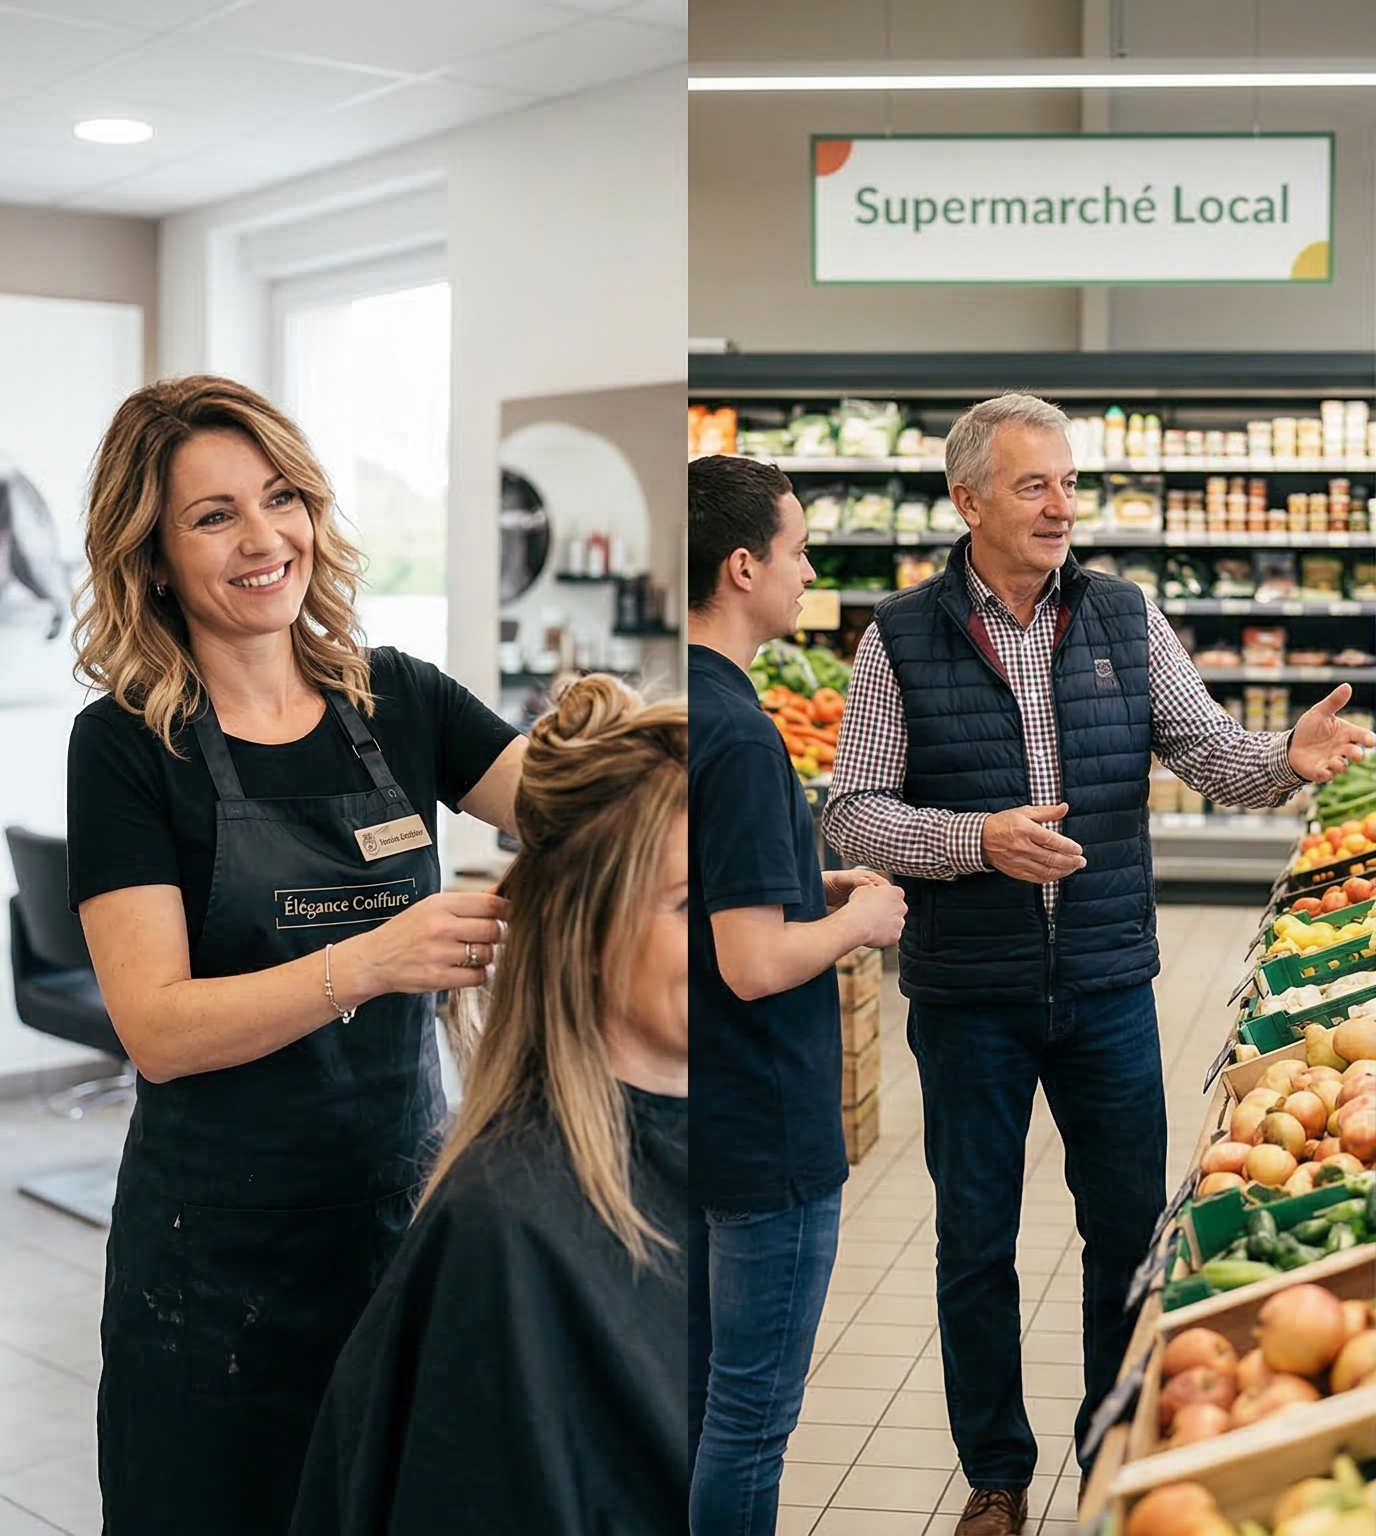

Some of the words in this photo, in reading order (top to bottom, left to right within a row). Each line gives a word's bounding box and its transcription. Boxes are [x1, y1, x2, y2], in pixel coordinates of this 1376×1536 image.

[854, 183, 1157, 233] Supermarché
[1173, 183, 1290, 225] Local
[283, 896, 349, 920] Élégance
[352, 890, 410, 912] Coiffure
